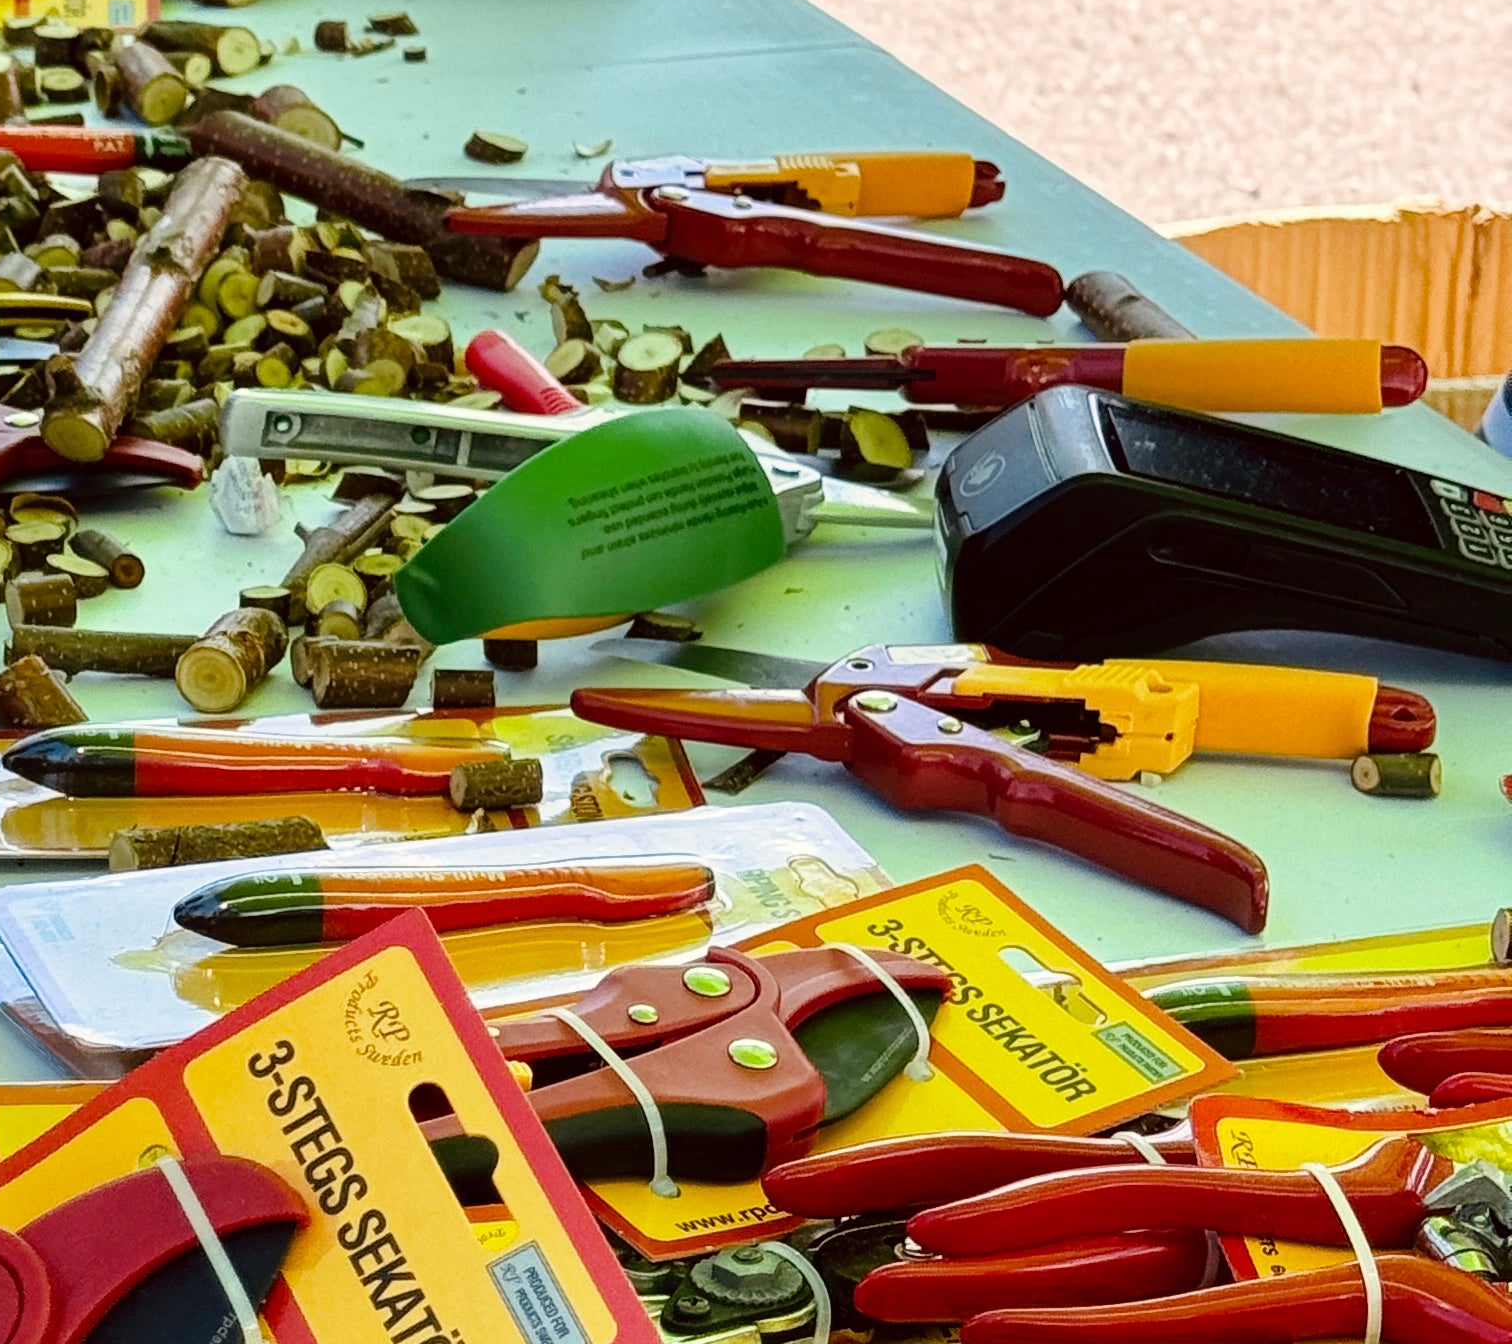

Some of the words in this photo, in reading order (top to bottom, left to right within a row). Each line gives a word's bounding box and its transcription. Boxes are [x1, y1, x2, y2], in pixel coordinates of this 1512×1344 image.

[343, 969, 379, 1043] Products
[367, 1000, 410, 1044] RP
[965, 1002, 1098, 1103] SEKATÖR
[246, 1038, 369, 1216] 3-STEGS
[513, 1287, 544, 1331] PRODUCTS
[522, 1264, 560, 1320] PRODUCED
[550, 1314, 571, 1340] FOR
